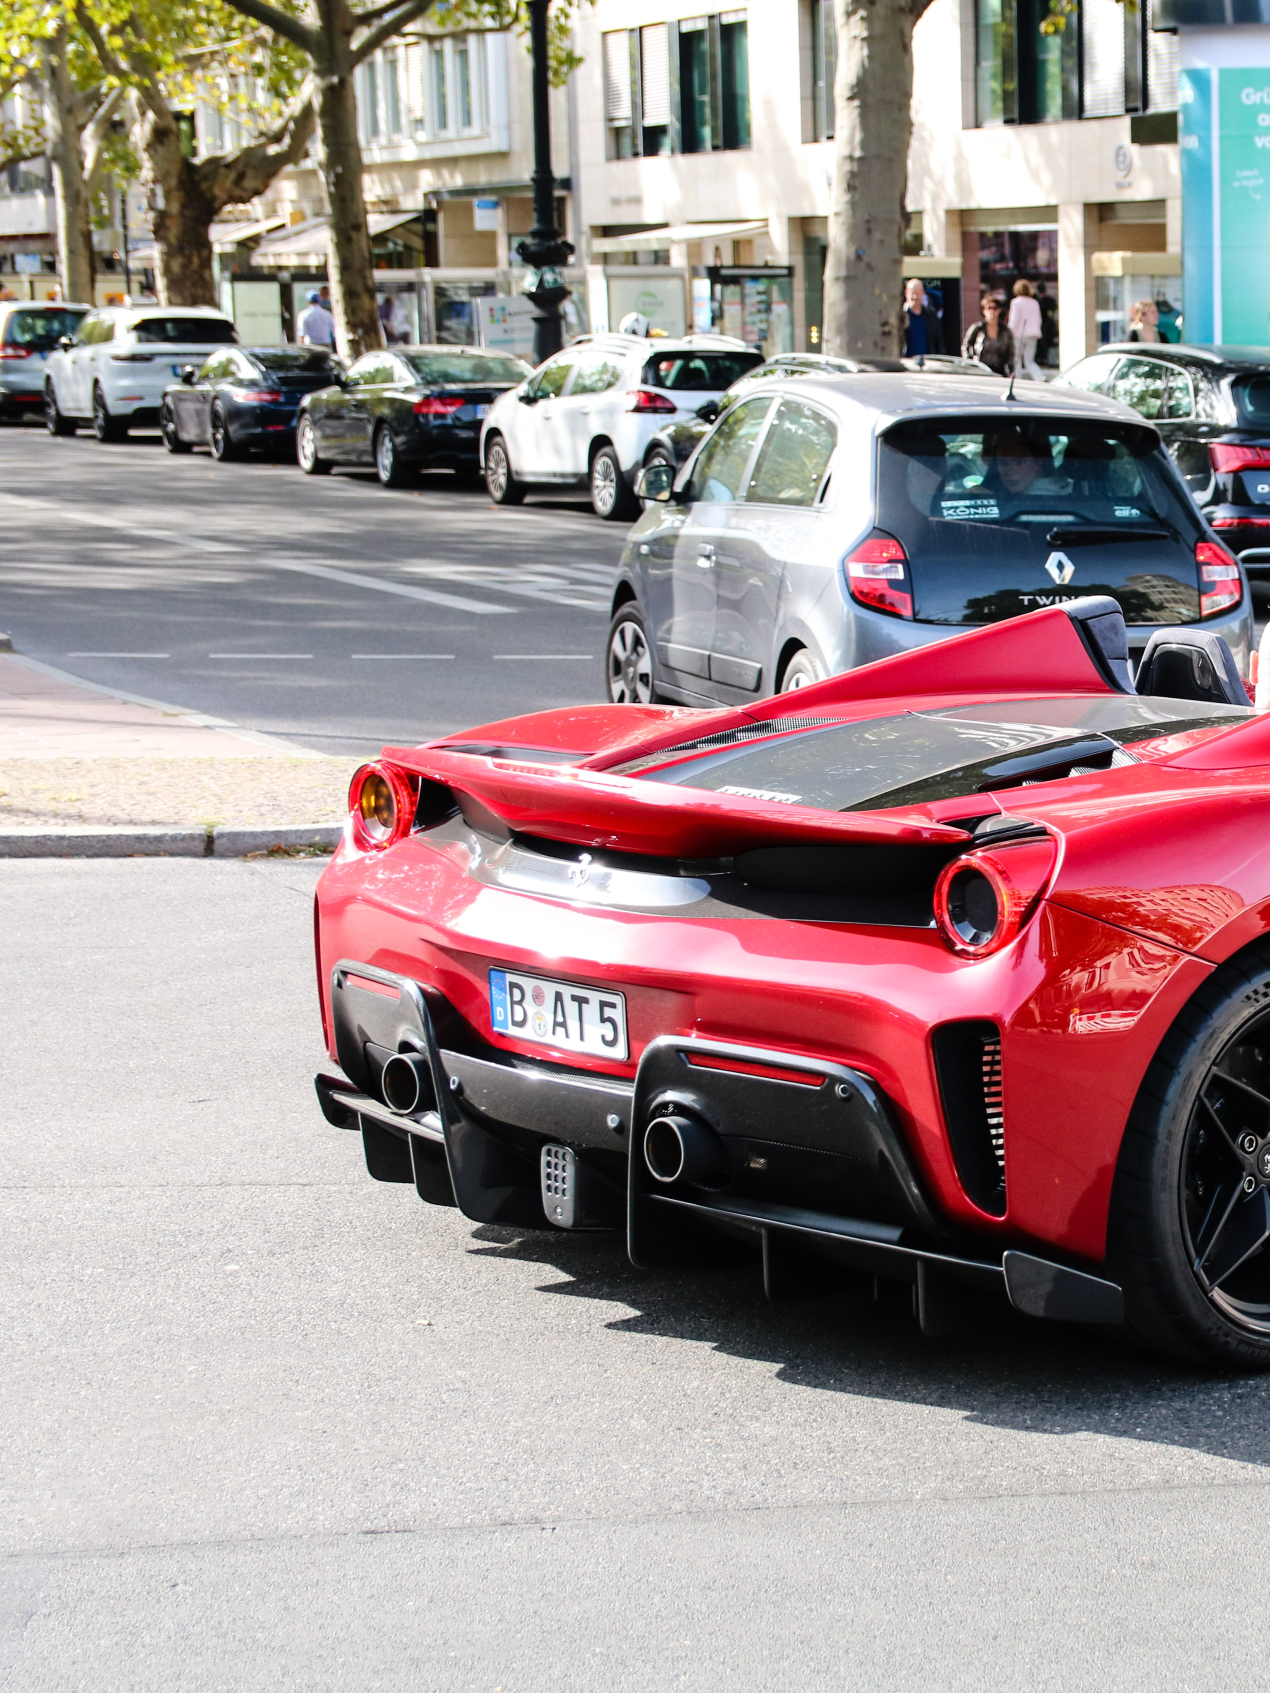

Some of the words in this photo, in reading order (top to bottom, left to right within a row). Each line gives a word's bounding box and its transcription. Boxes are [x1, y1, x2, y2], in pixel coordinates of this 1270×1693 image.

[943, 506, 1000, 517] KÖNIG
[1018, 595, 1088, 606] TWIN
[508, 980, 528, 1029] B
[496, 1007, 505, 1021] D
